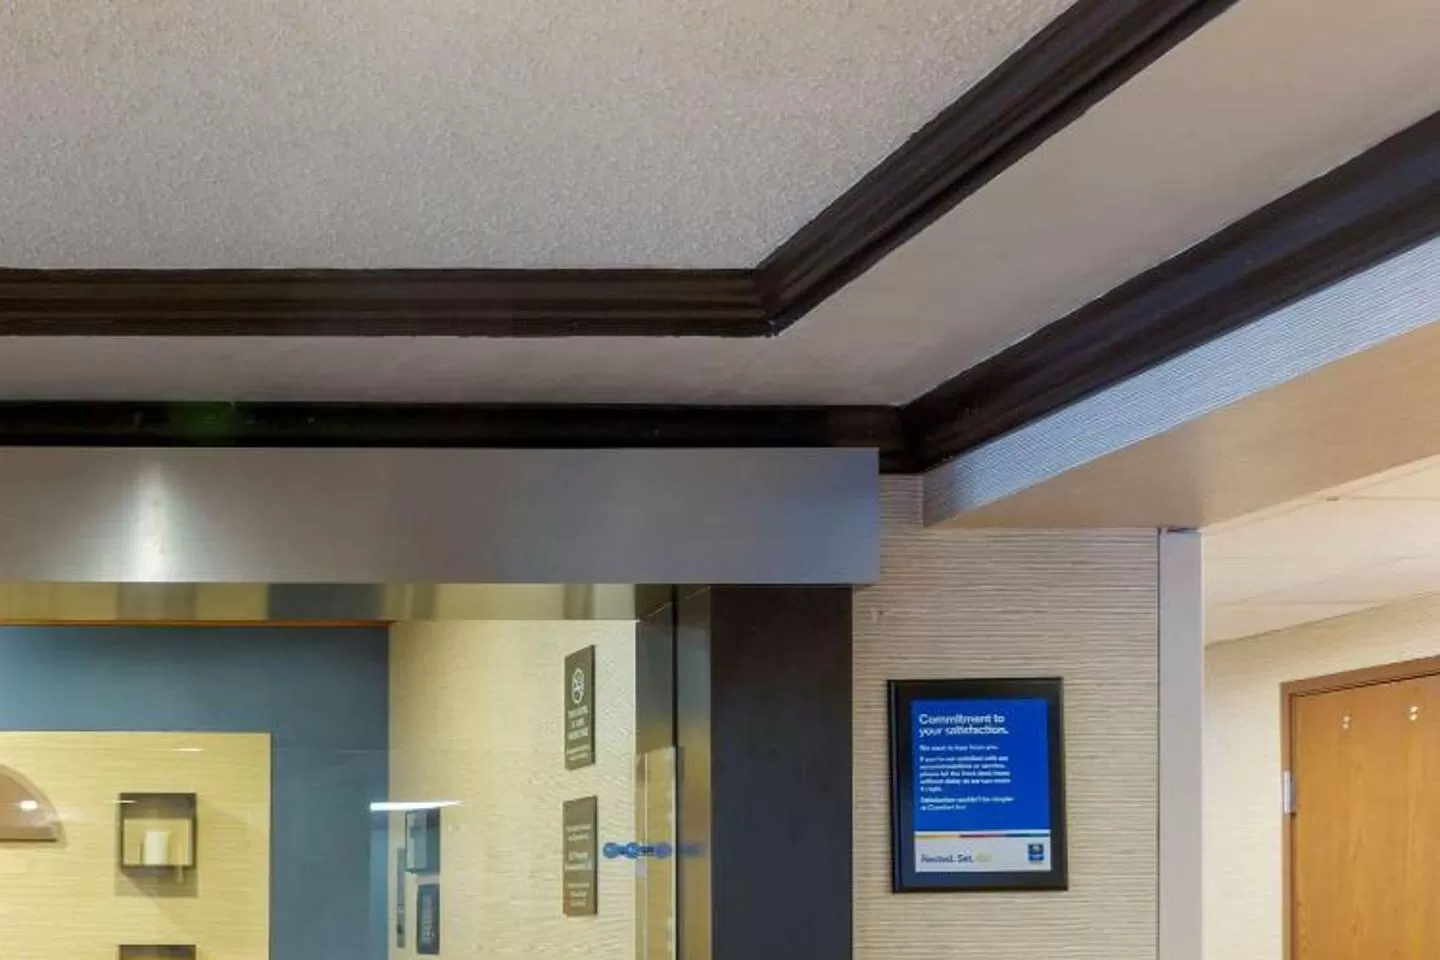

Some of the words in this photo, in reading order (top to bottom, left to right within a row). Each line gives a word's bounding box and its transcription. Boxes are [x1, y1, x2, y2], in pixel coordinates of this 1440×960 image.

[919, 713, 991, 724] Commitment
[994, 713, 1005, 723] to
[919, 727, 943, 738] your
